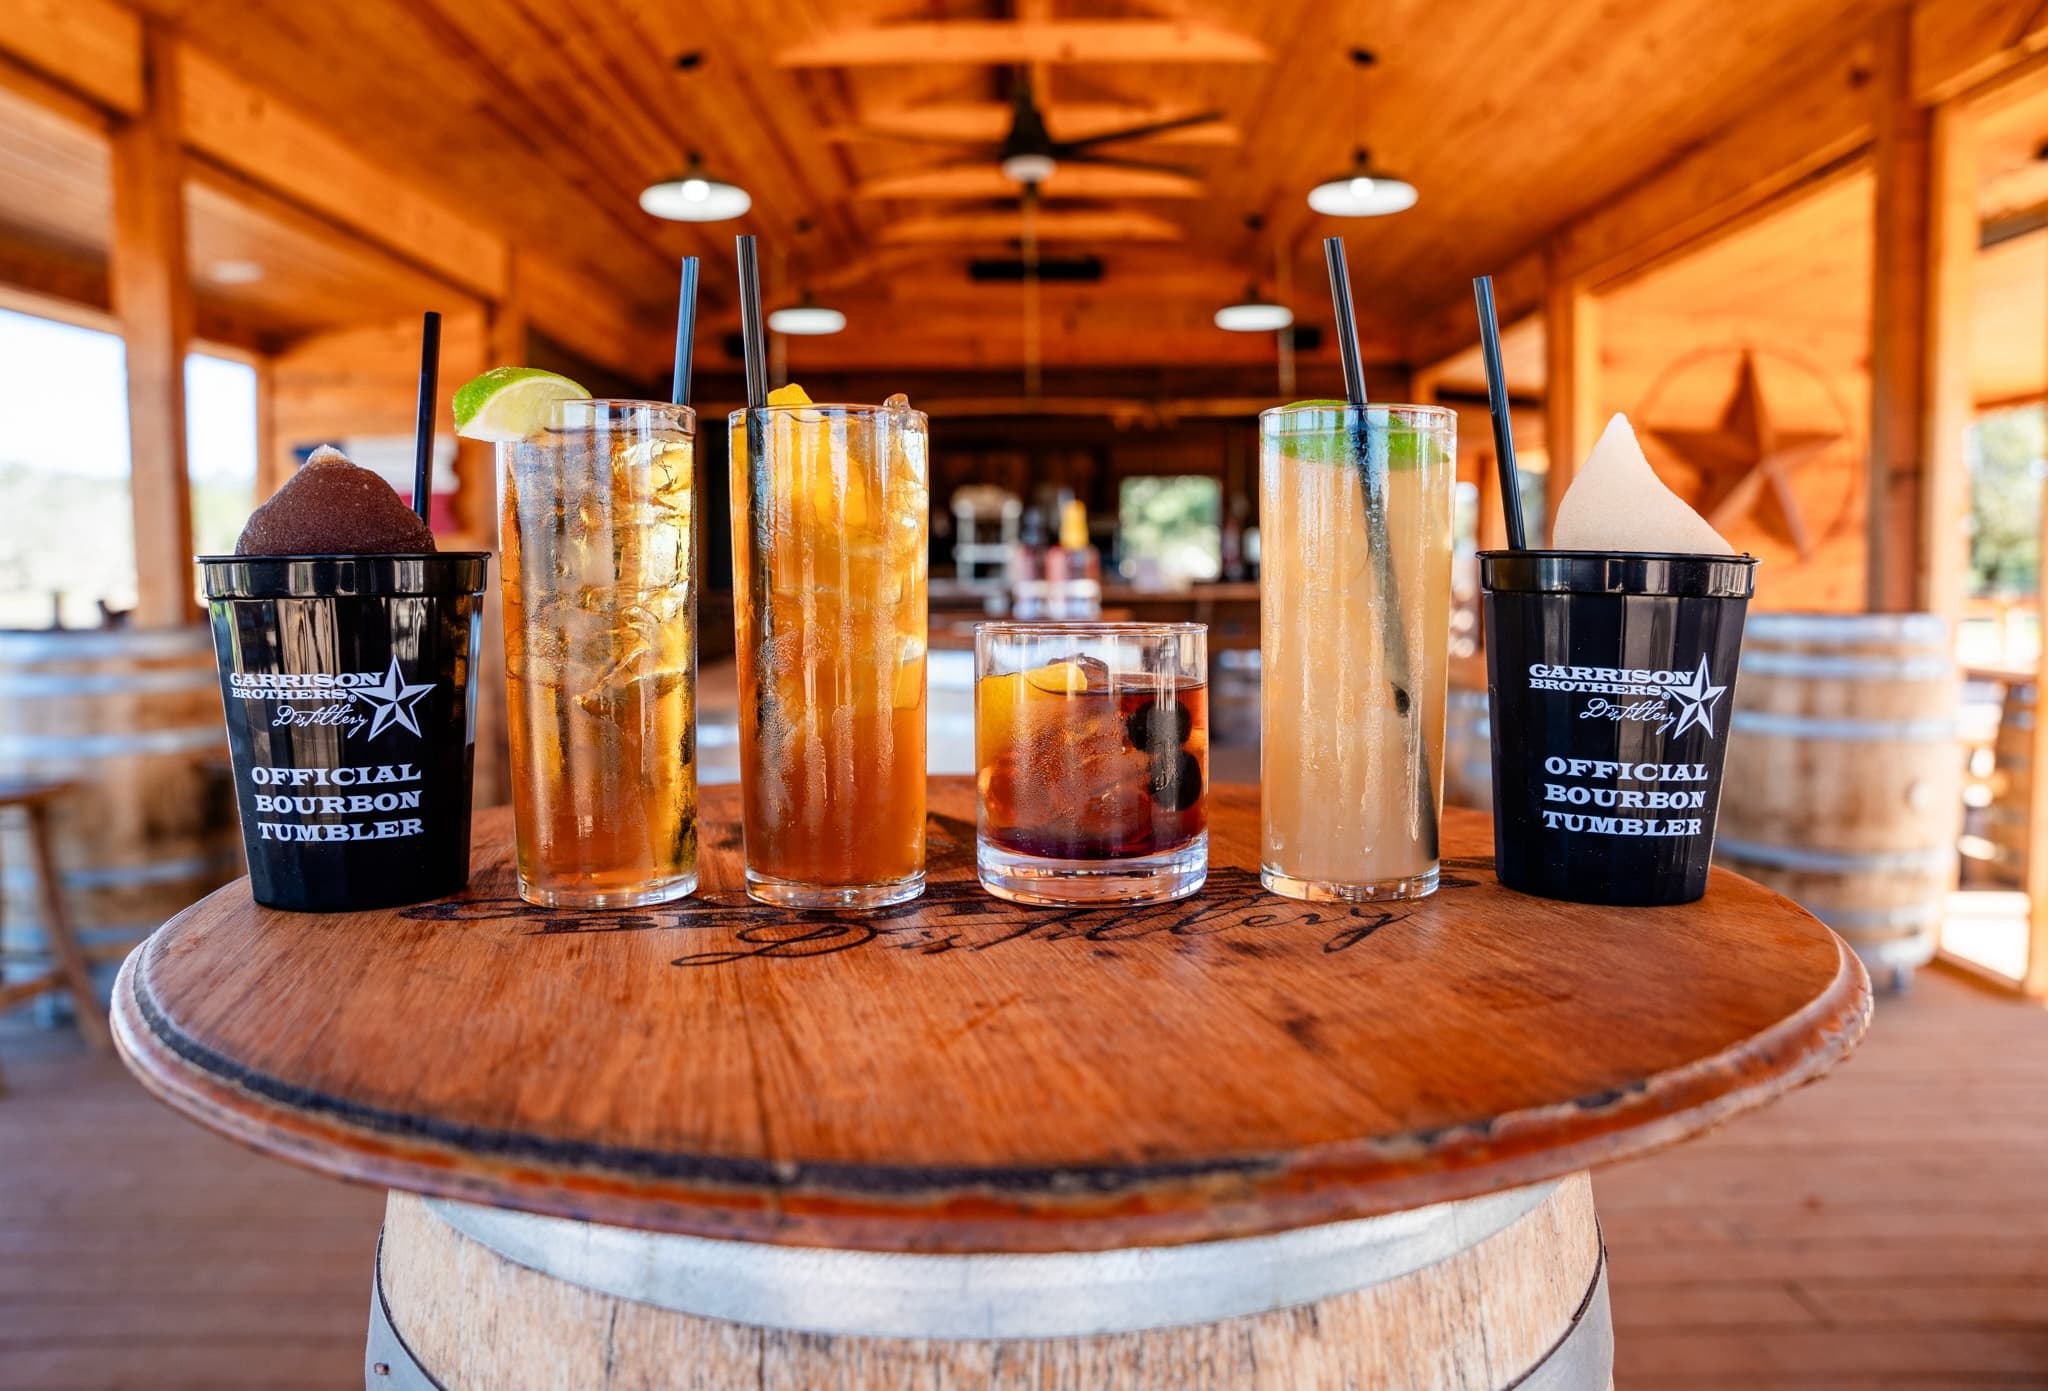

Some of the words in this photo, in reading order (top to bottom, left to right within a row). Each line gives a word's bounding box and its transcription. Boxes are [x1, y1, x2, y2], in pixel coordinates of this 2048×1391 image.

[229, 671, 385, 688] GARRISON
[1529, 663, 1695, 685] GARRISON
[272, 704, 369, 739] Distillery
[1579, 697, 1677, 735] Distillery
[251, 763, 422, 786] OFFICIAL
[1544, 756, 1708, 781] OFFICIAL
[254, 790, 423, 814] BOURBON
[1544, 783, 1707, 809] BOURBON
[258, 818, 424, 842] TUMBLER
[1542, 810, 1702, 836] TUMBLER
